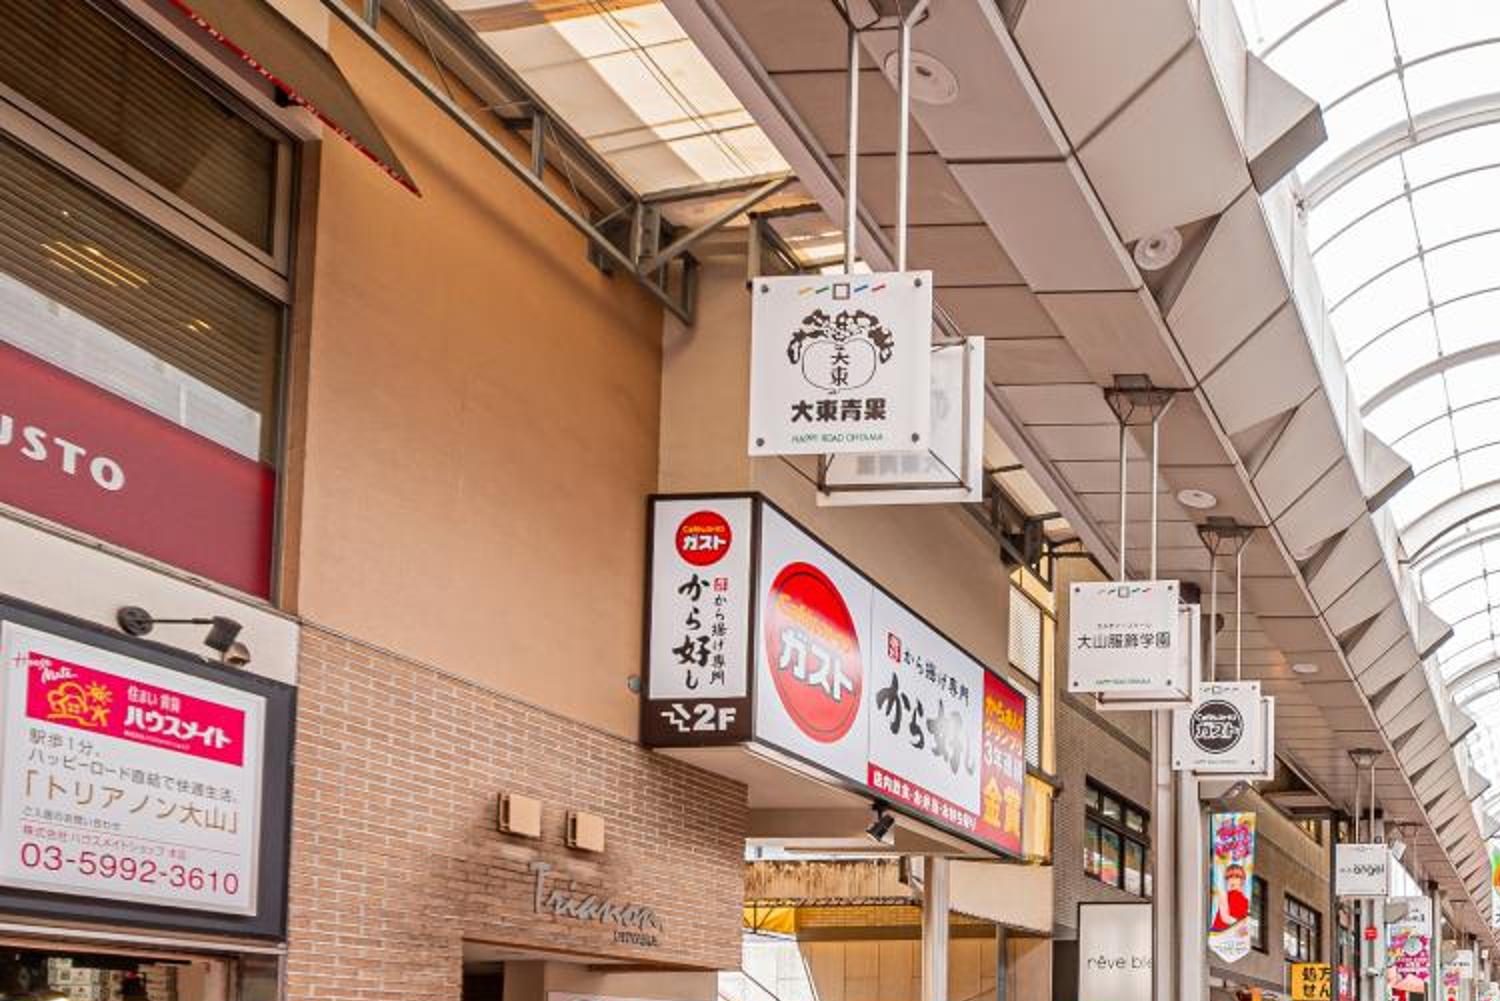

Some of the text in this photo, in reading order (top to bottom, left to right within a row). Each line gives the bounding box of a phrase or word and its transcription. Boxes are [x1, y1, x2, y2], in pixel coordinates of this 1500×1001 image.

[791, 398, 887, 422] 大東青果
[683, 534, 727, 551] ガスト
[672, 573, 711, 690] から好し
[1077, 631, 1171, 650] 大山服飾学園
[776, 626, 854, 703] ガスト
[124, 705, 233, 750] ハウスメイト
[692, 703, 737, 731] 2F
[20, 842, 240, 896] 03-5992-3610
[1087, 954, 1125, 969] rêve
